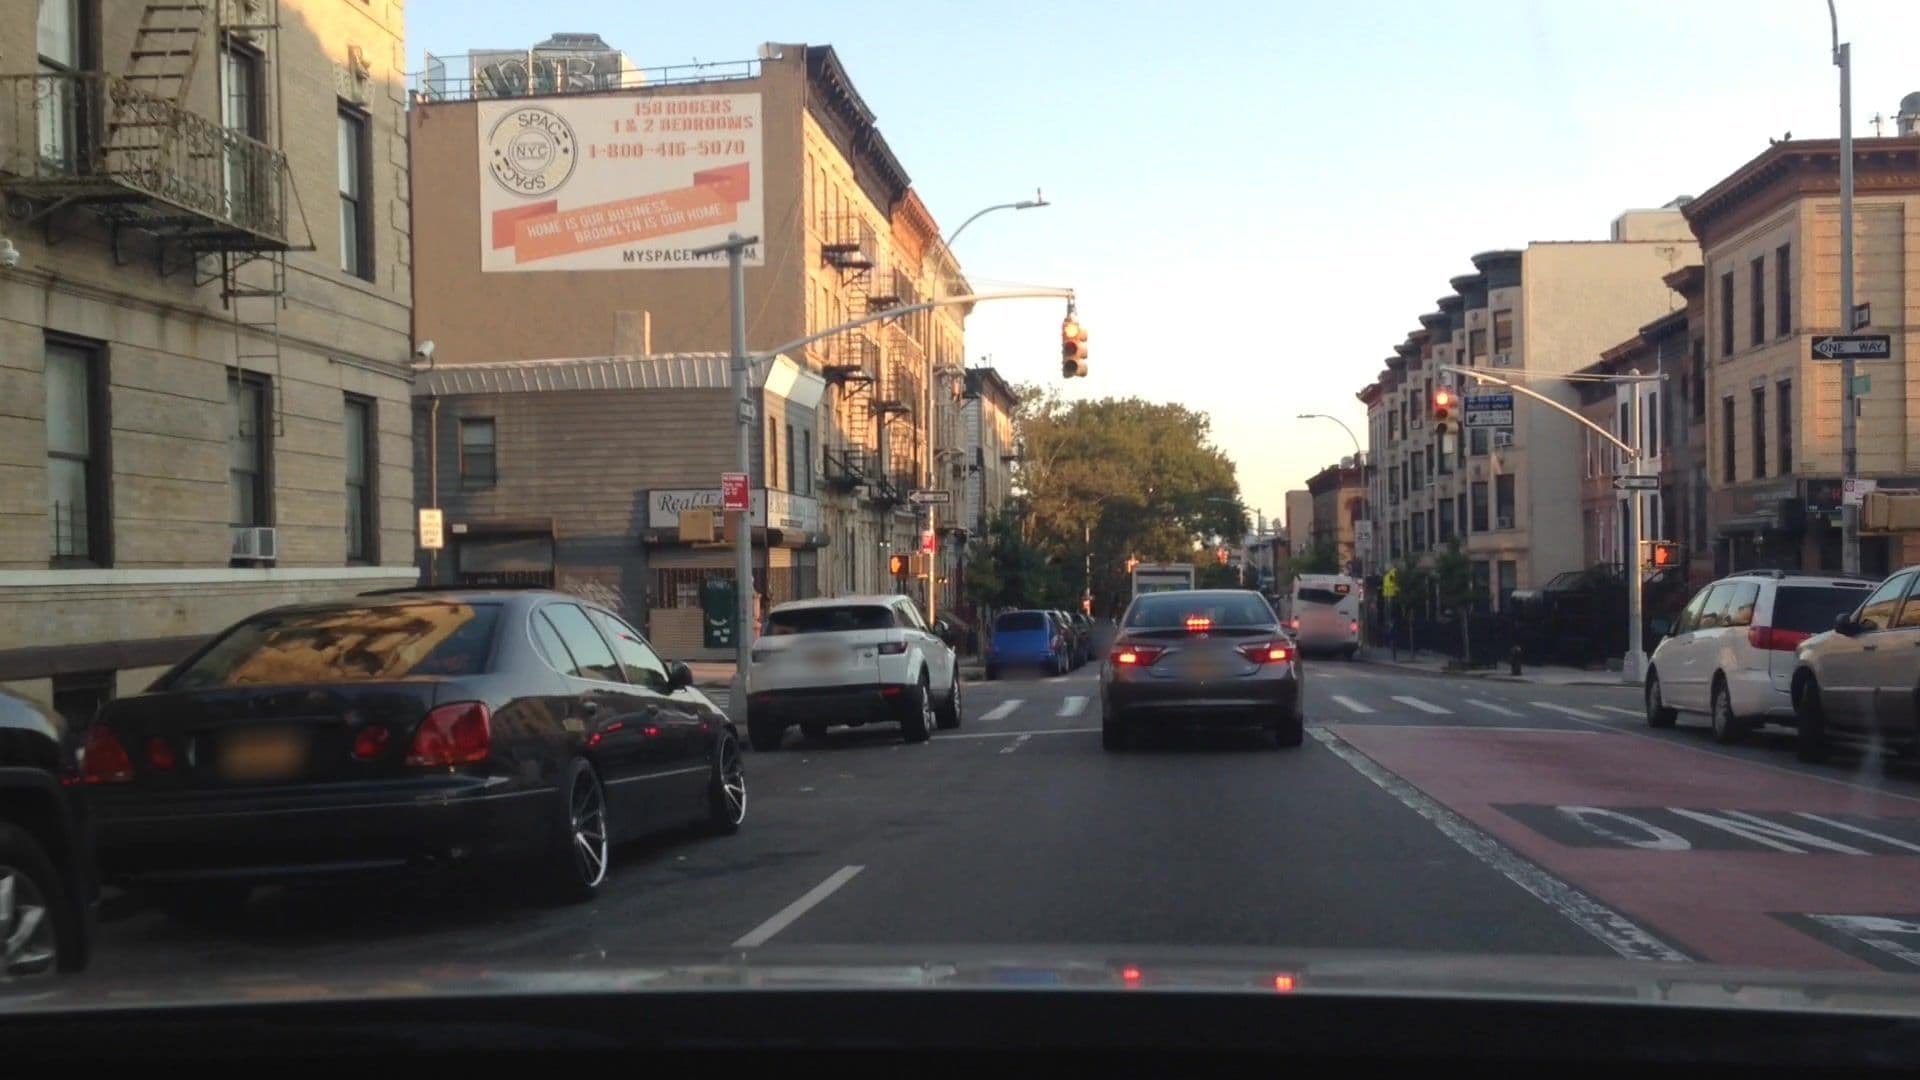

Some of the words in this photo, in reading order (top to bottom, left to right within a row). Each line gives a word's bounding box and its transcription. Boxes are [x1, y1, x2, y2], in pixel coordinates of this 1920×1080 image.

[634, 101, 662, 116] 158
[667, 99, 732, 115] ROGERS
[643, 118, 654, 132] 2
[660, 115, 754, 131] BEDROOMS
[516, 144, 548, 157] NYC
[527, 221, 562, 239] HOME
[565, 217, 577, 230] IS
[580, 213, 605, 228] OUR
[574, 219, 642, 243] BROOKLYN
[645, 216, 658, 230] IS
[661, 212, 686, 227] OUR
[1820, 343, 1845, 353] ONE
[1859, 343, 1883, 353] WAY
[660, 491, 699, 514] Real
